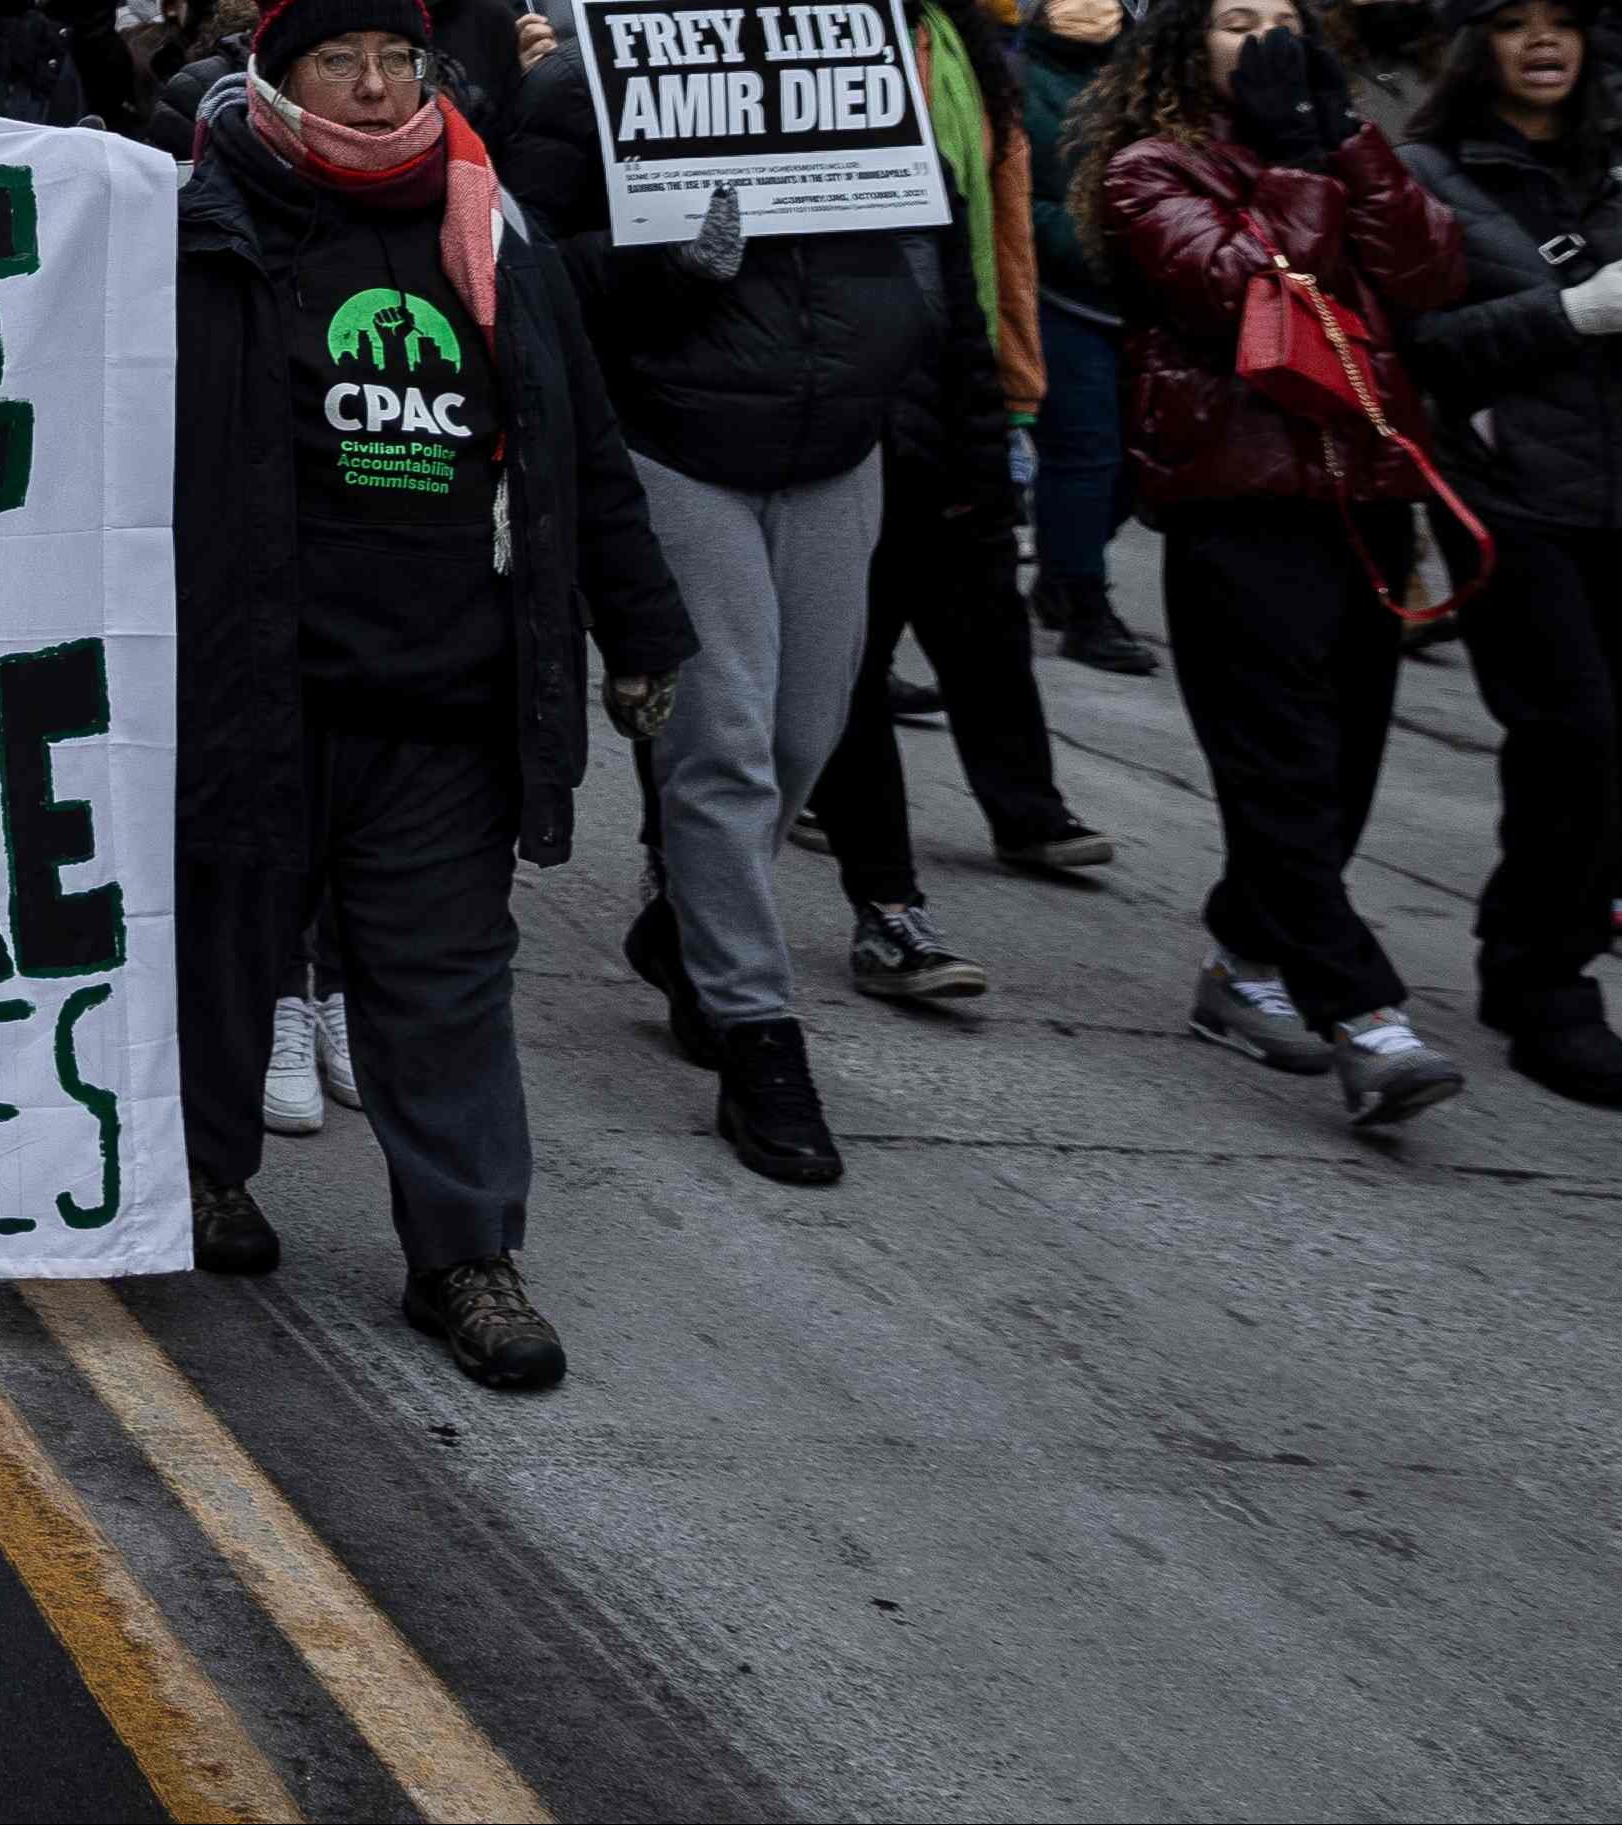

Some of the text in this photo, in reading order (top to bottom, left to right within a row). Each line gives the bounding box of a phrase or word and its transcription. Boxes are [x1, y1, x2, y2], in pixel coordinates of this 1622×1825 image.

[605, 3, 895, 68] FREY LIED,
[618, 64, 906, 143] AMIR DIED
[324, 382, 473, 437] CPAC
[337, 453, 454, 481] Accountability
[341, 439, 406, 456] Civilian
[345, 470, 449, 494] Commission
